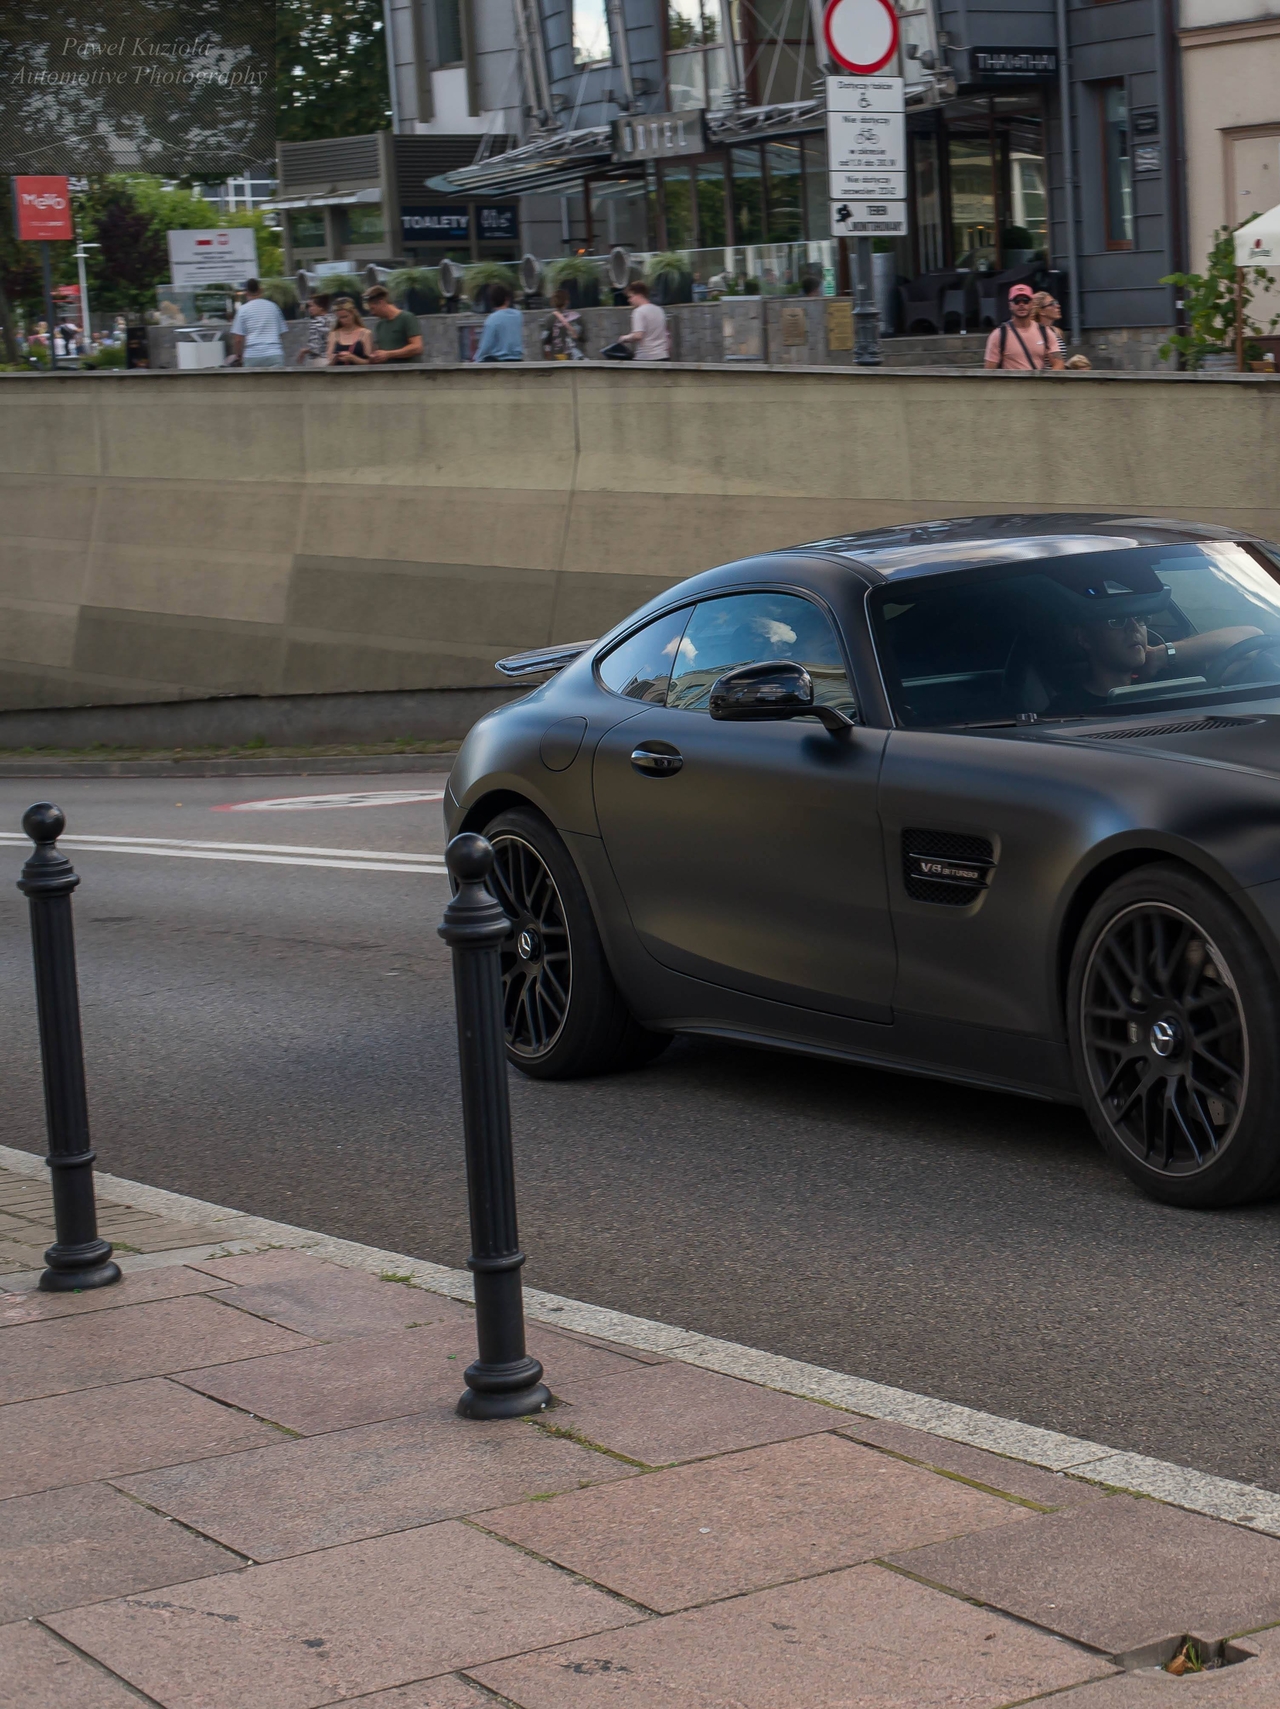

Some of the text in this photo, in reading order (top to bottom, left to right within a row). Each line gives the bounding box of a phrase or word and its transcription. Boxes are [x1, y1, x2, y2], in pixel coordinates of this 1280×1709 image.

[401, 215, 469, 228] TOALETY
[921, 862, 979, 879] V8 BITURBO
